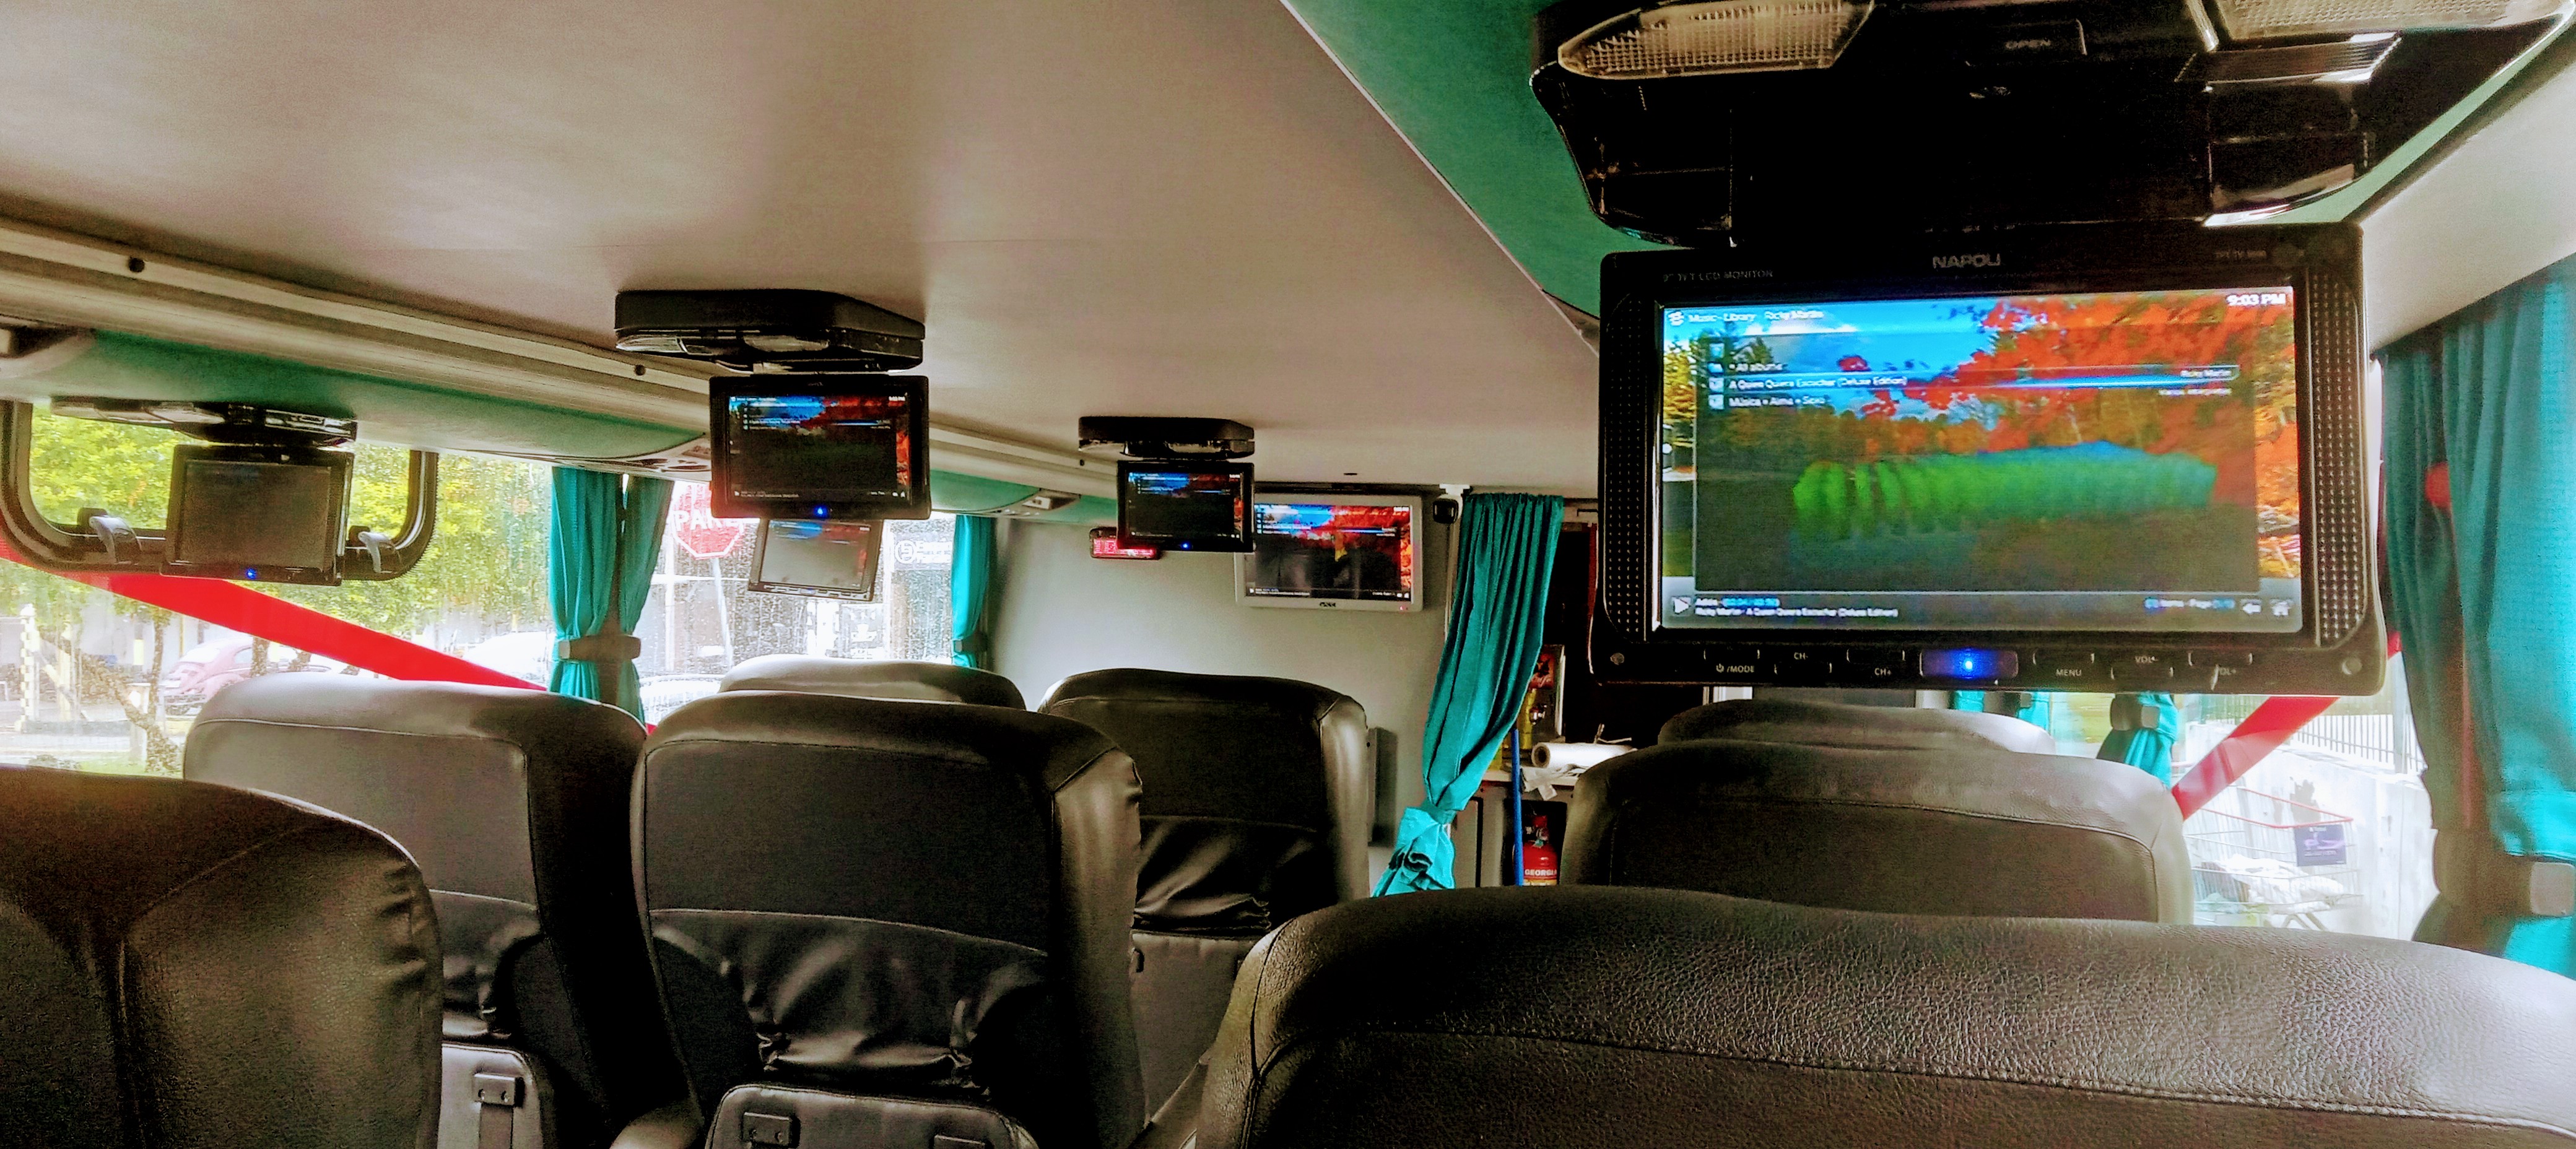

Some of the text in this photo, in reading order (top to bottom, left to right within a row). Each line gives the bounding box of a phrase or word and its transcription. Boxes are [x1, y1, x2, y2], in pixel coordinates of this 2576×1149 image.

[2004, 40, 2052, 50] OPEN
[1932, 253, 2001, 268] NAPOLI
[1724, 269, 1773, 279] MONITOR
[2226, 293, 2286, 306] 9:03 PM
[1723, 313, 1756, 321] Library
[1790, 310, 1823, 319] Martin
[1729, 380, 1738, 389] A
[1873, 376, 1908, 386] Edition)
[2056, 669, 2082, 677] MENU
